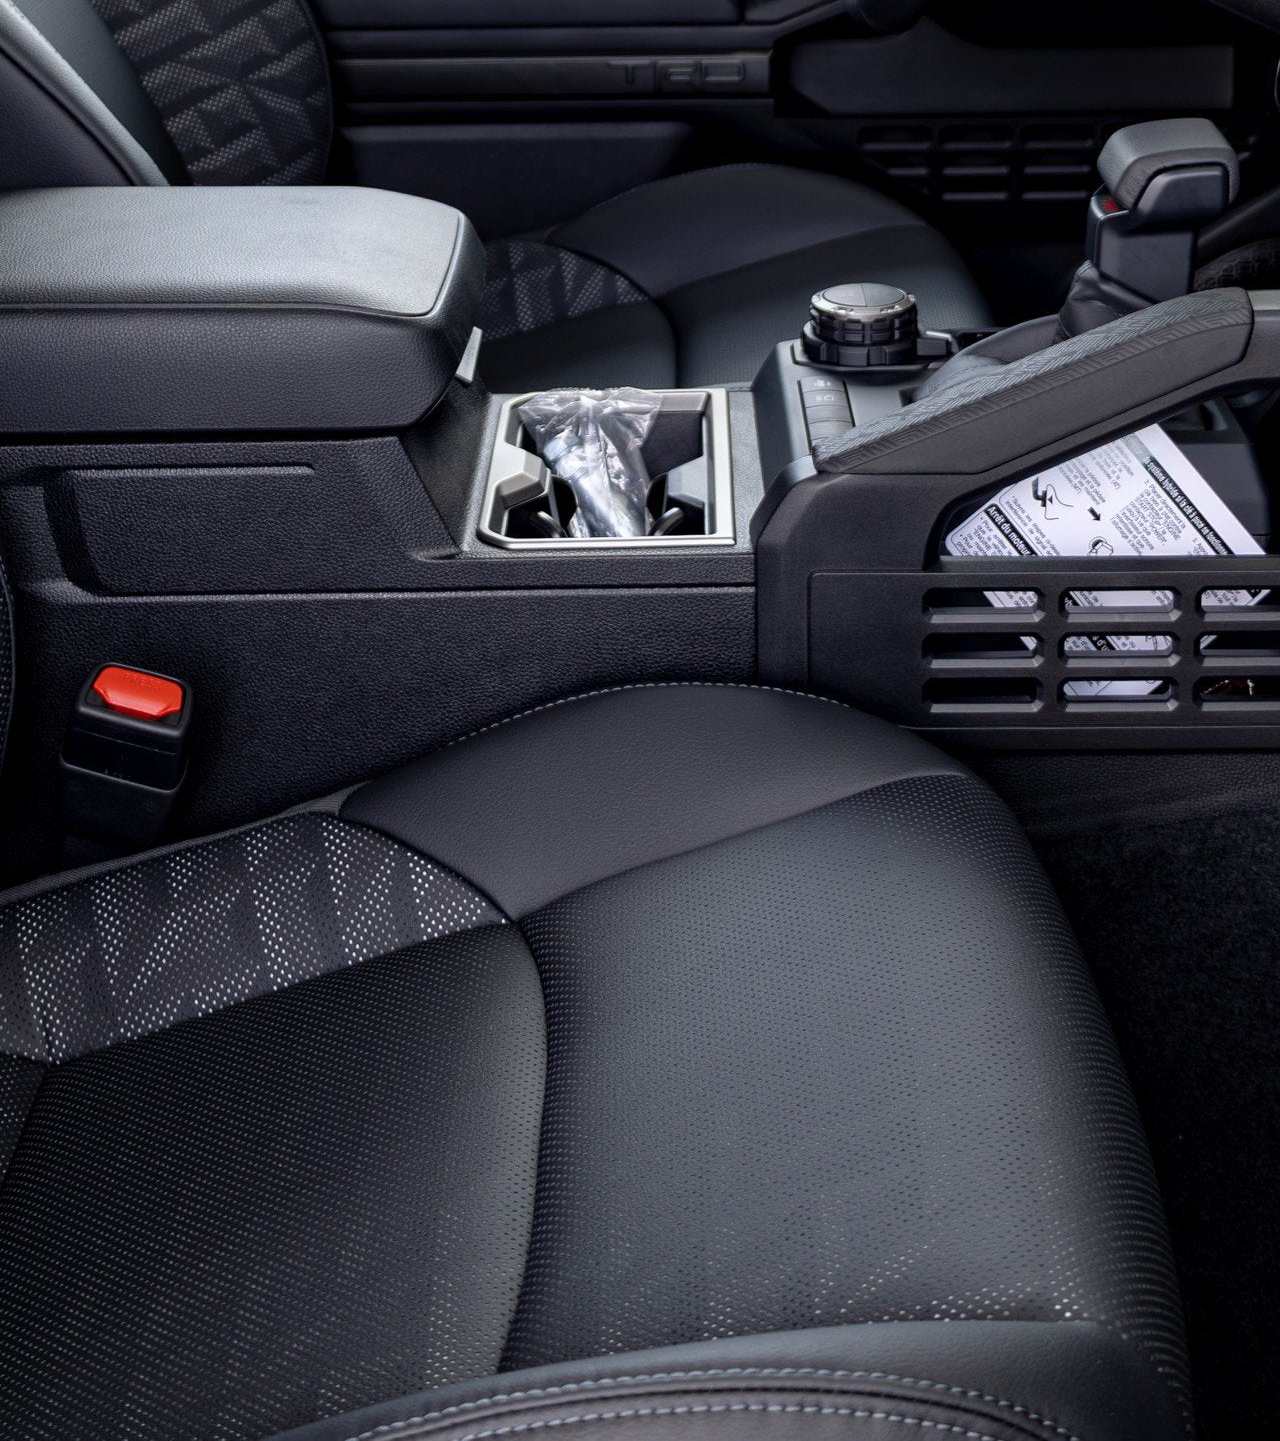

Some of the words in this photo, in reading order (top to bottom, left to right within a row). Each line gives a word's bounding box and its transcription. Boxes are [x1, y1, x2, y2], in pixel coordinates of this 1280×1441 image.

[986, 504, 1006, 525] Arrêt
[1000, 520, 1013, 534] du
[1006, 530, 1032, 556] moteur
